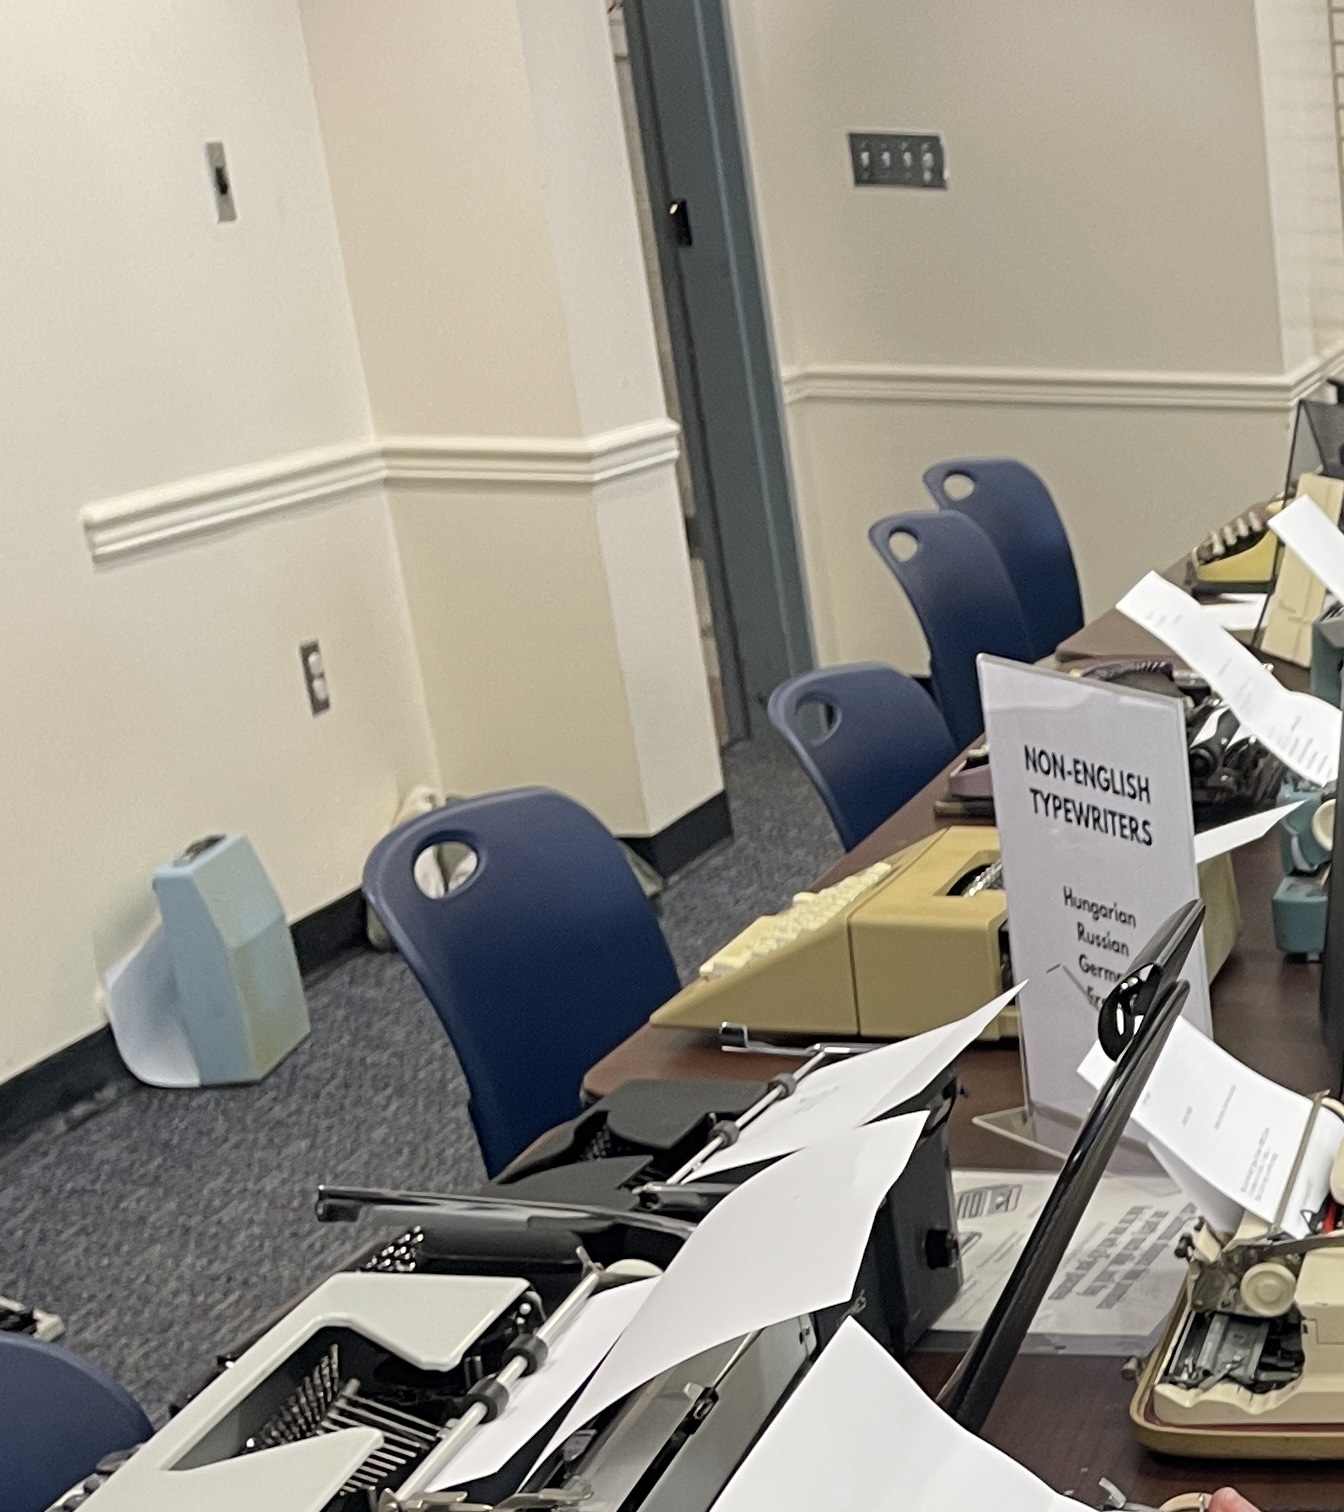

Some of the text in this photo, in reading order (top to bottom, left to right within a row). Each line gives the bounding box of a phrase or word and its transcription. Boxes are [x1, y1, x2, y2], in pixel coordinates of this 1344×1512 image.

[1024, 745, 1151, 804] NON-ENGLISH
[1029, 788, 1152, 847] TYPEWRITERS
[1063, 885, 1137, 929] Hungarian
[1077, 922, 1130, 957] Russian
